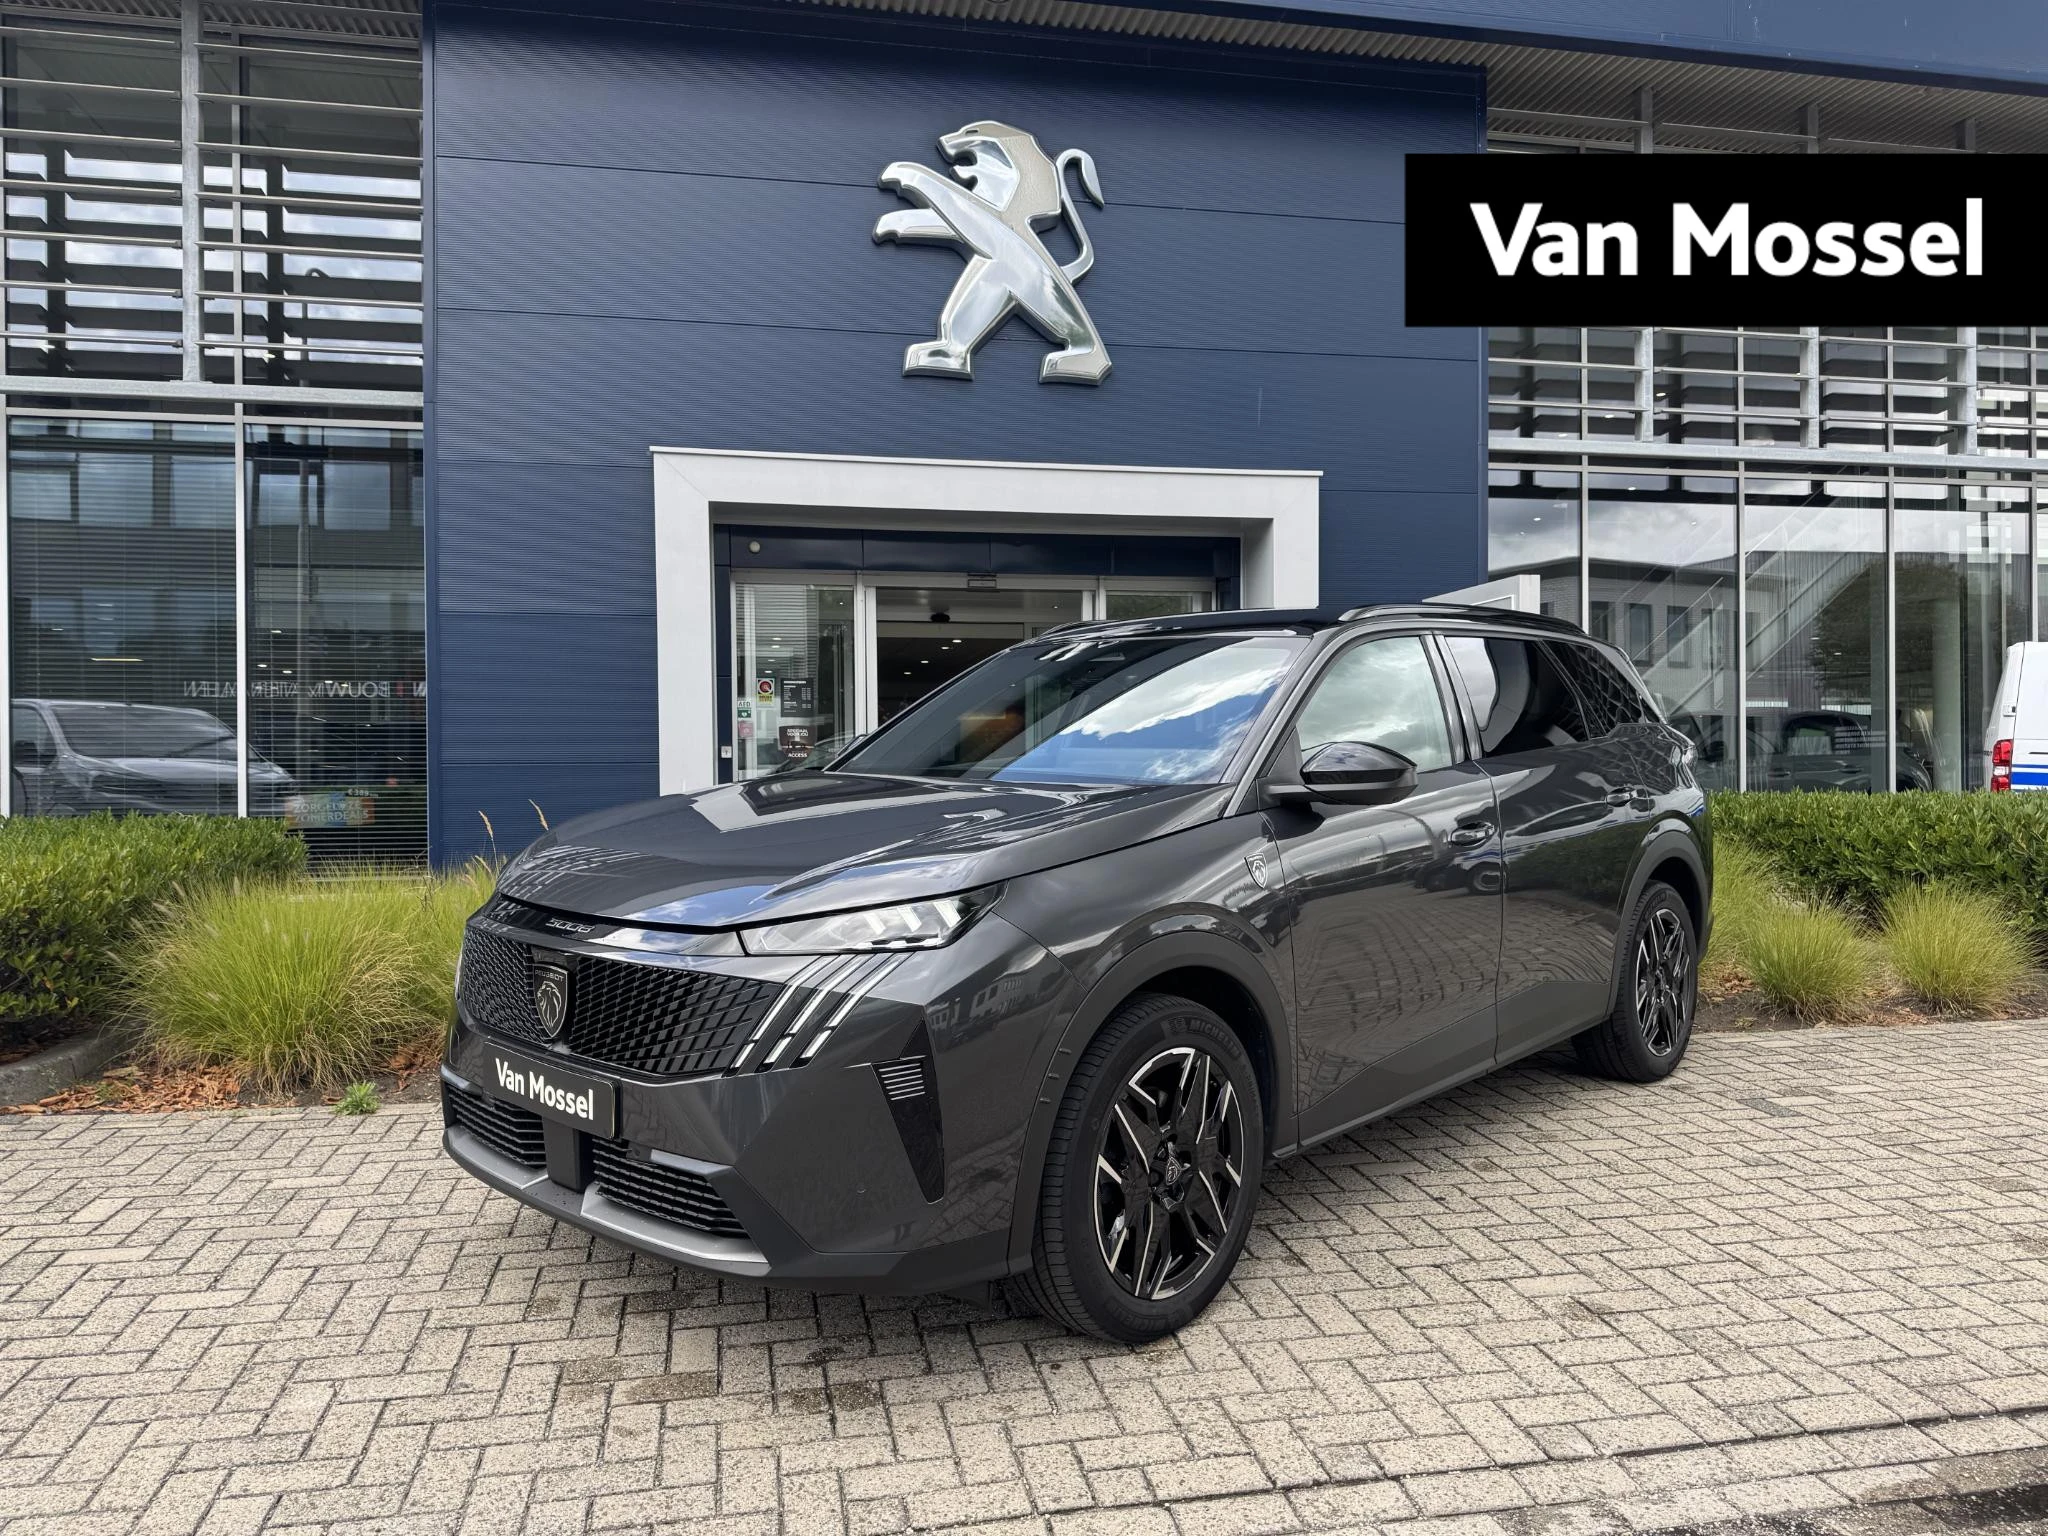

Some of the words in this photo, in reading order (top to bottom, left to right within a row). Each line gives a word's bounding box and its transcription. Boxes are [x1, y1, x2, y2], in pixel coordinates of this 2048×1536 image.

[535, 969, 564, 981] PEUGEOT
[495, 1057, 525, 1096] Van
[529, 1070, 594, 1121] Mossel
